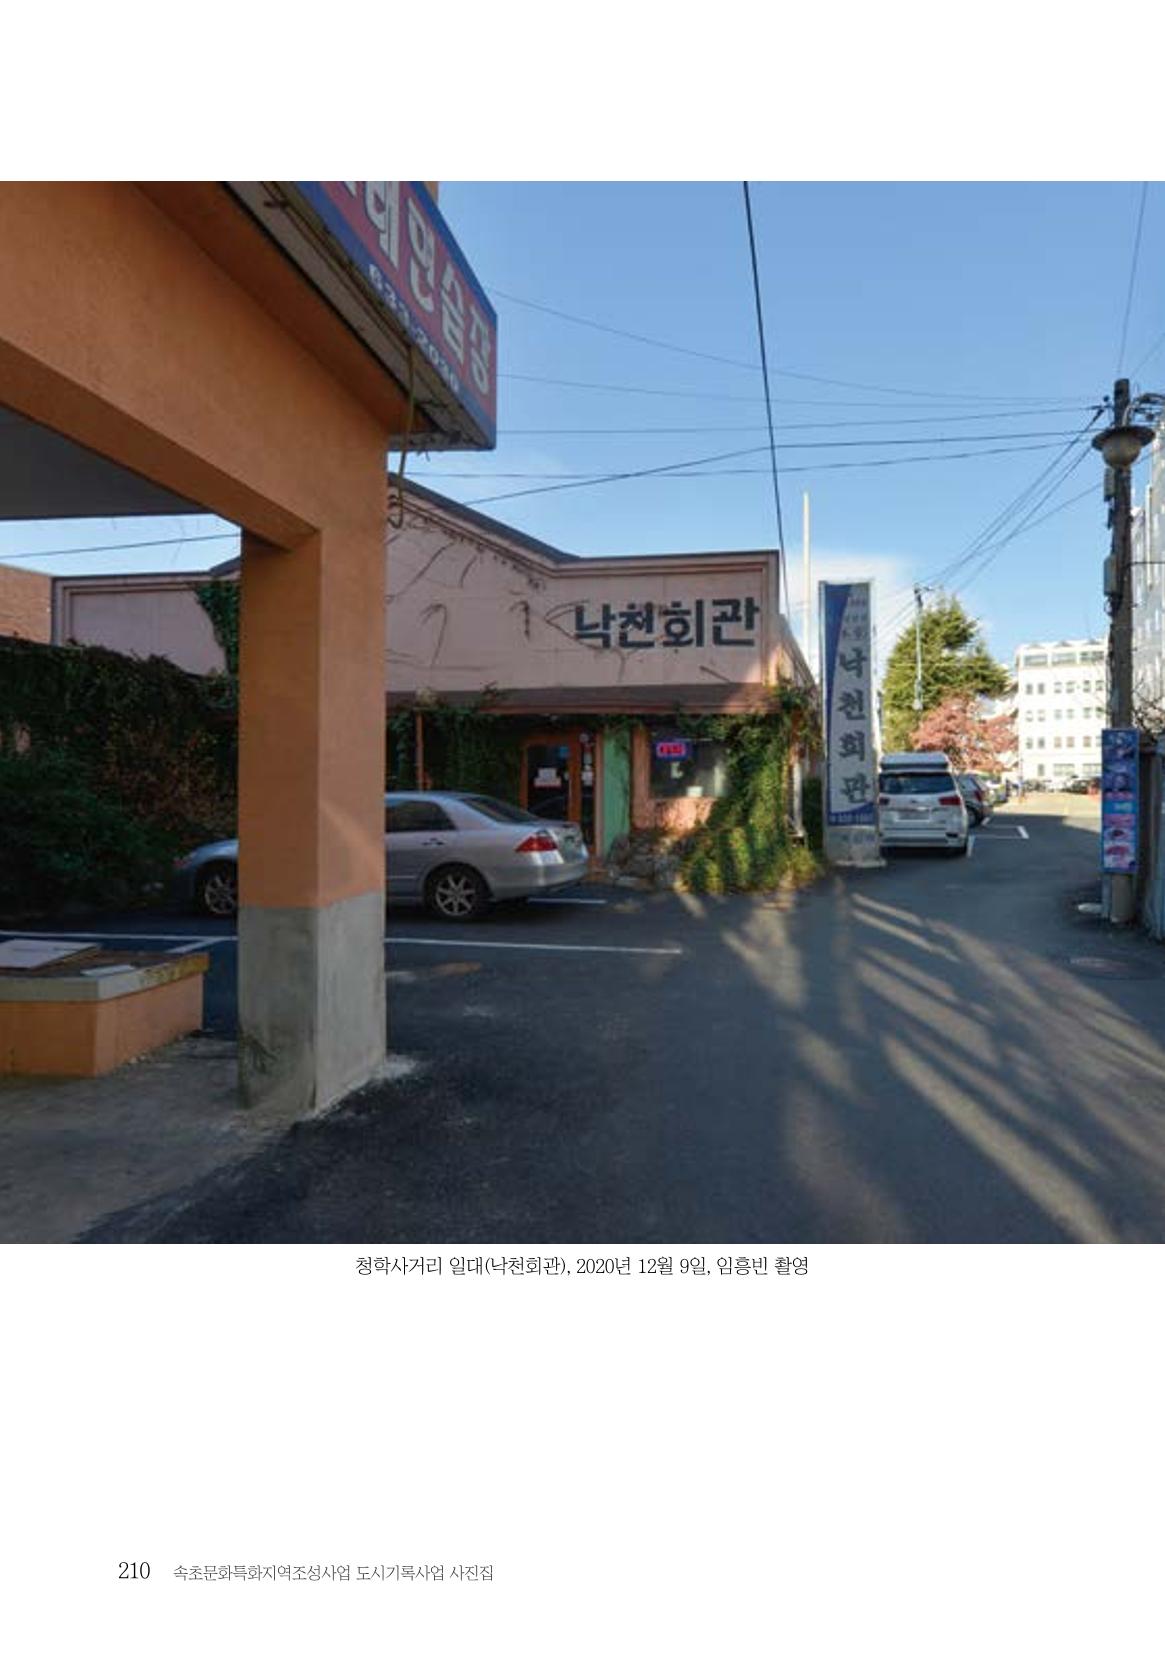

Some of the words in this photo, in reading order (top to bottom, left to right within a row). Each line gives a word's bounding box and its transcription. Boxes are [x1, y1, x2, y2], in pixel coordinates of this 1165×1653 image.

[345, 182, 490, 394] 래연습장
[575, 597, 760, 648] 낙천회관
[837, 648, 870, 804] 낙천회관
